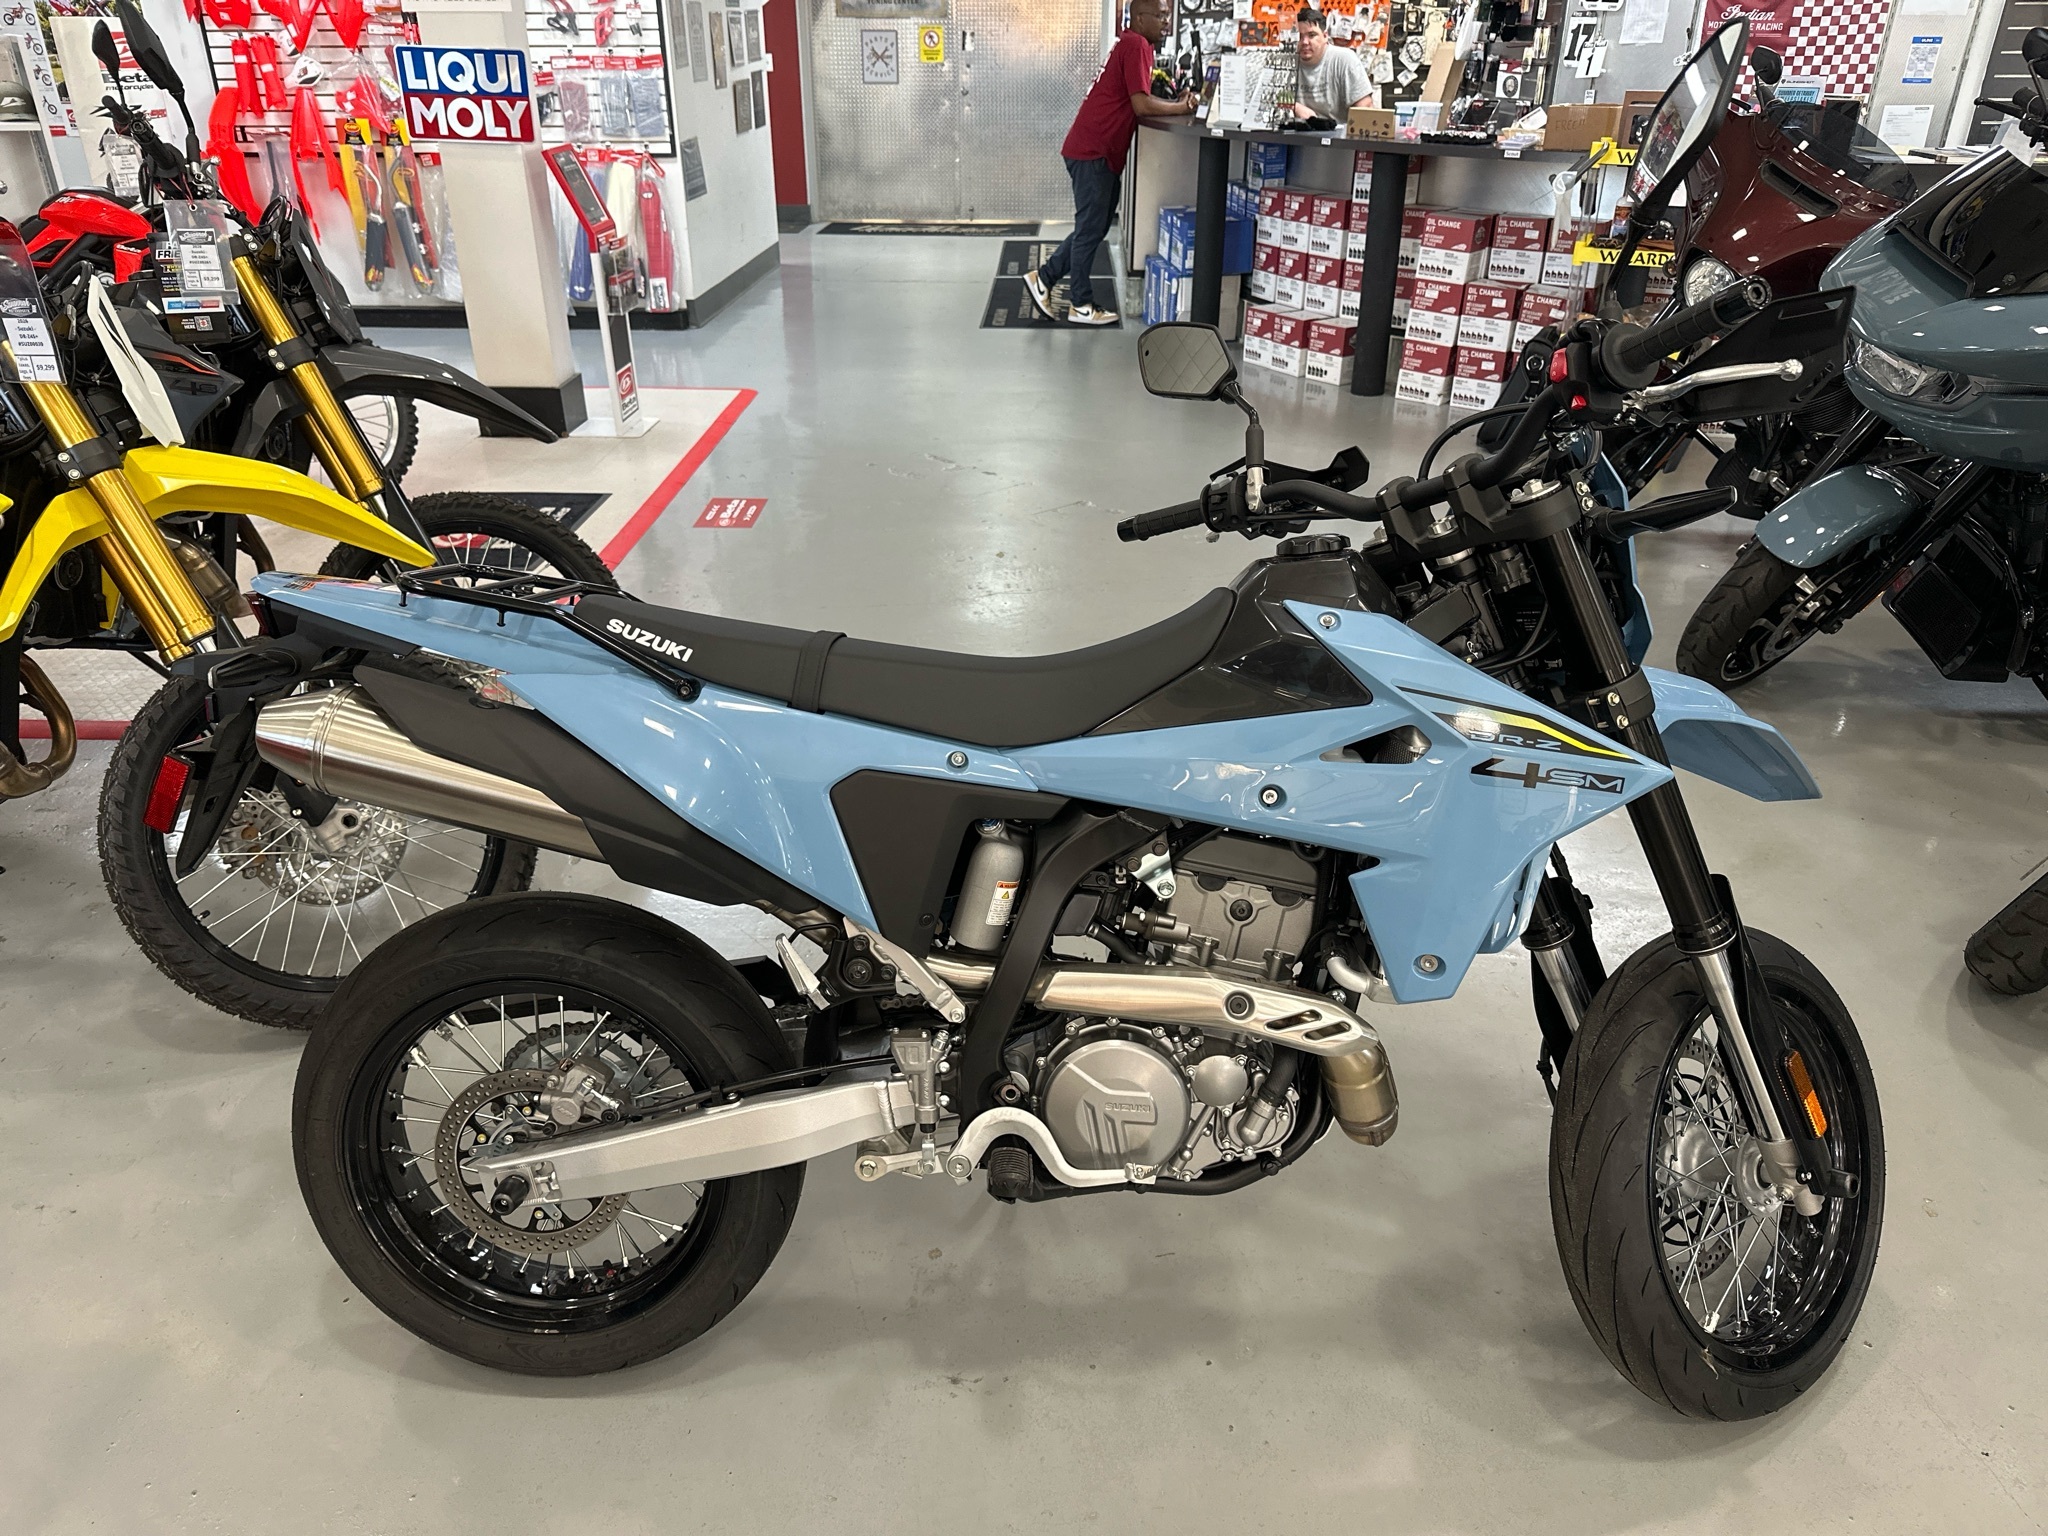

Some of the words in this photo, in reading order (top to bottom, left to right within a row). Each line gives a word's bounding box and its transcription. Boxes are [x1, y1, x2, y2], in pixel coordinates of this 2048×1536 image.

[1721, 4, 1776, 21] Indian
[1756, 23, 1784, 31] RACING
[1564, 23, 1597, 62] 17
[1586, 54, 1594, 76] 1
[402, 51, 523, 95] LIQUI
[410, 97, 529, 139] MOLY
[1426, 225, 1436, 233] KIT
[1427, 218, 1437, 226] OIL
[1438, 219, 1462, 229] CHANGE
[1499, 220, 1509, 228] OIL
[1510, 221, 1535, 229] CHANGE
[1600, 249, 1677, 267] WARD
[1417, 281, 1427, 289] OIL
[1428, 283, 1451, 293] CHANGE
[1468, 287, 1478, 295] OIL
[1479, 288, 1503, 298] CHANGE
[1467, 294, 1478, 302] KIT
[1525, 294, 1536, 303] OIL
[1537, 296, 1563, 307] CHANGE
[1524, 302, 1534, 310] KIT
[1319, 327, 1337, 336] CHANGE
[1405, 349, 1414, 357] KIT
[1406, 342, 1415, 351] OIL
[1416, 344, 1438, 355] CHANGE
[1460, 349, 1470, 357] OIL
[1470, 350, 1494, 361] CHANGE
[1460, 356, 1469, 364] KIT
[606, 618, 694, 663] SUZUKI
[1469, 730, 1562, 752] DR-Z
[1105, 1102, 1151, 1113] SUZUKI
